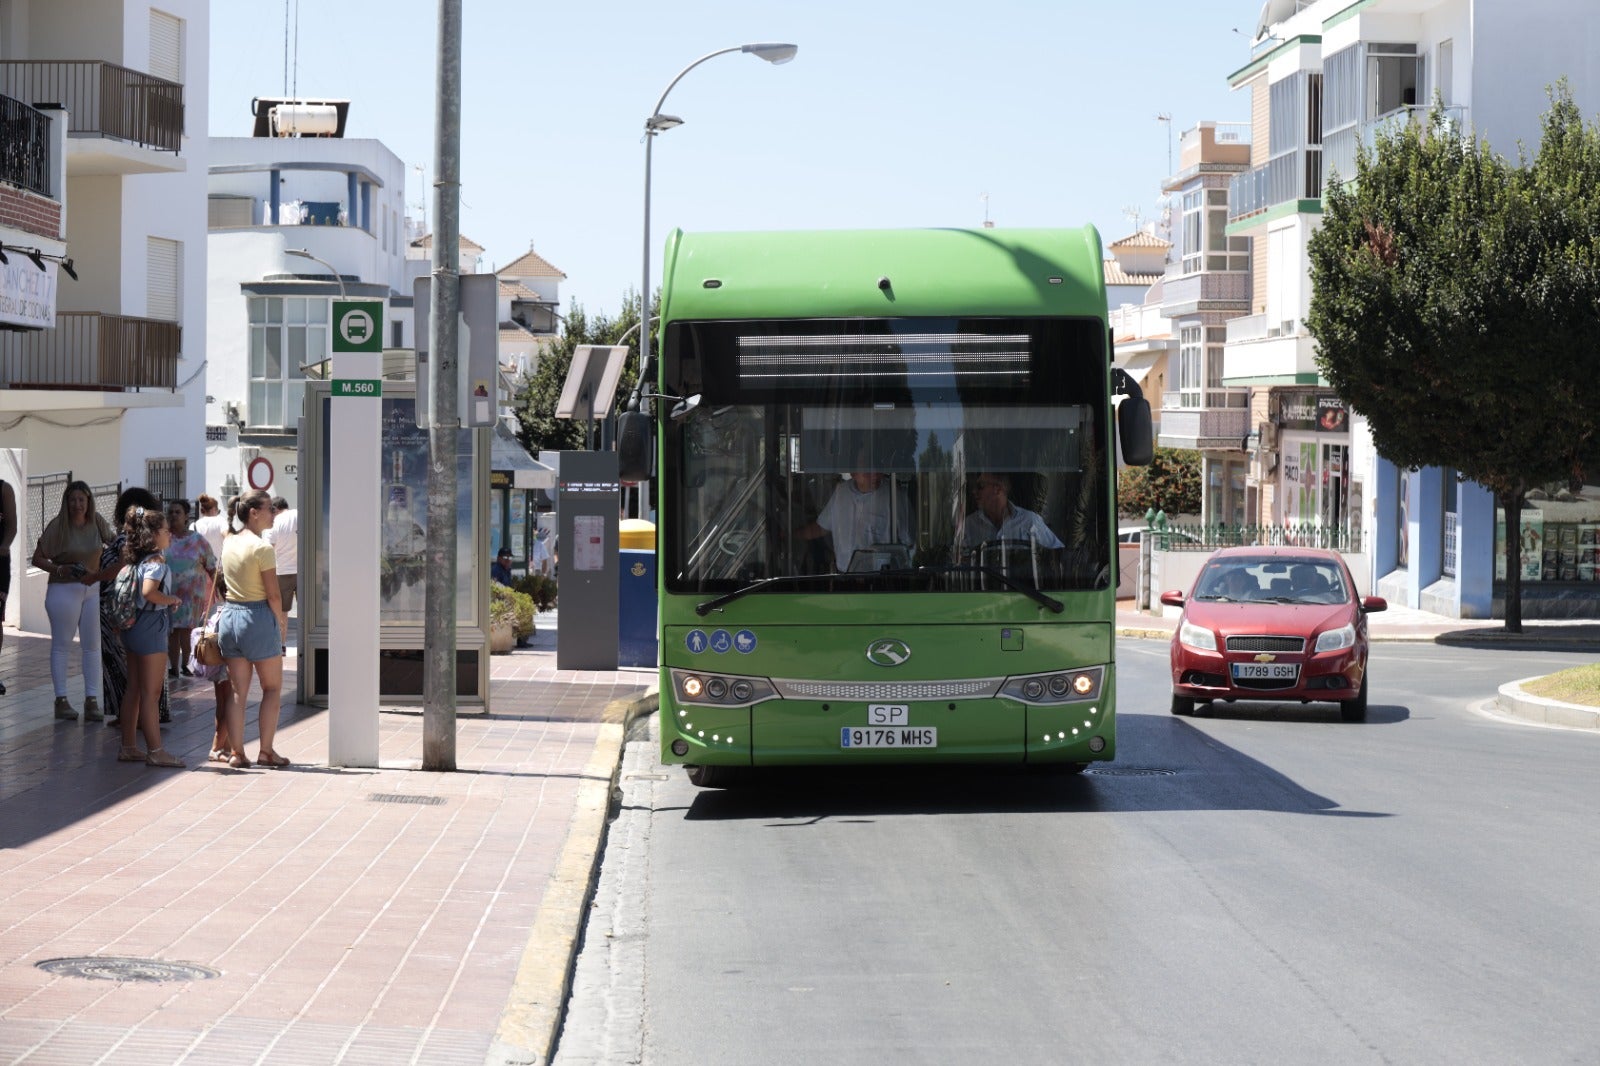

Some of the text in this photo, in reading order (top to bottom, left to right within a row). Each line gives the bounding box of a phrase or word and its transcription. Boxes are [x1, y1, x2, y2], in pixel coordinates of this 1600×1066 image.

[342, 383, 374, 393] M.560
[1244, 666, 1294, 677] 1789 GSH
[874, 707, 903, 723] SP
[853, 730, 932, 745] 9176 MHS
